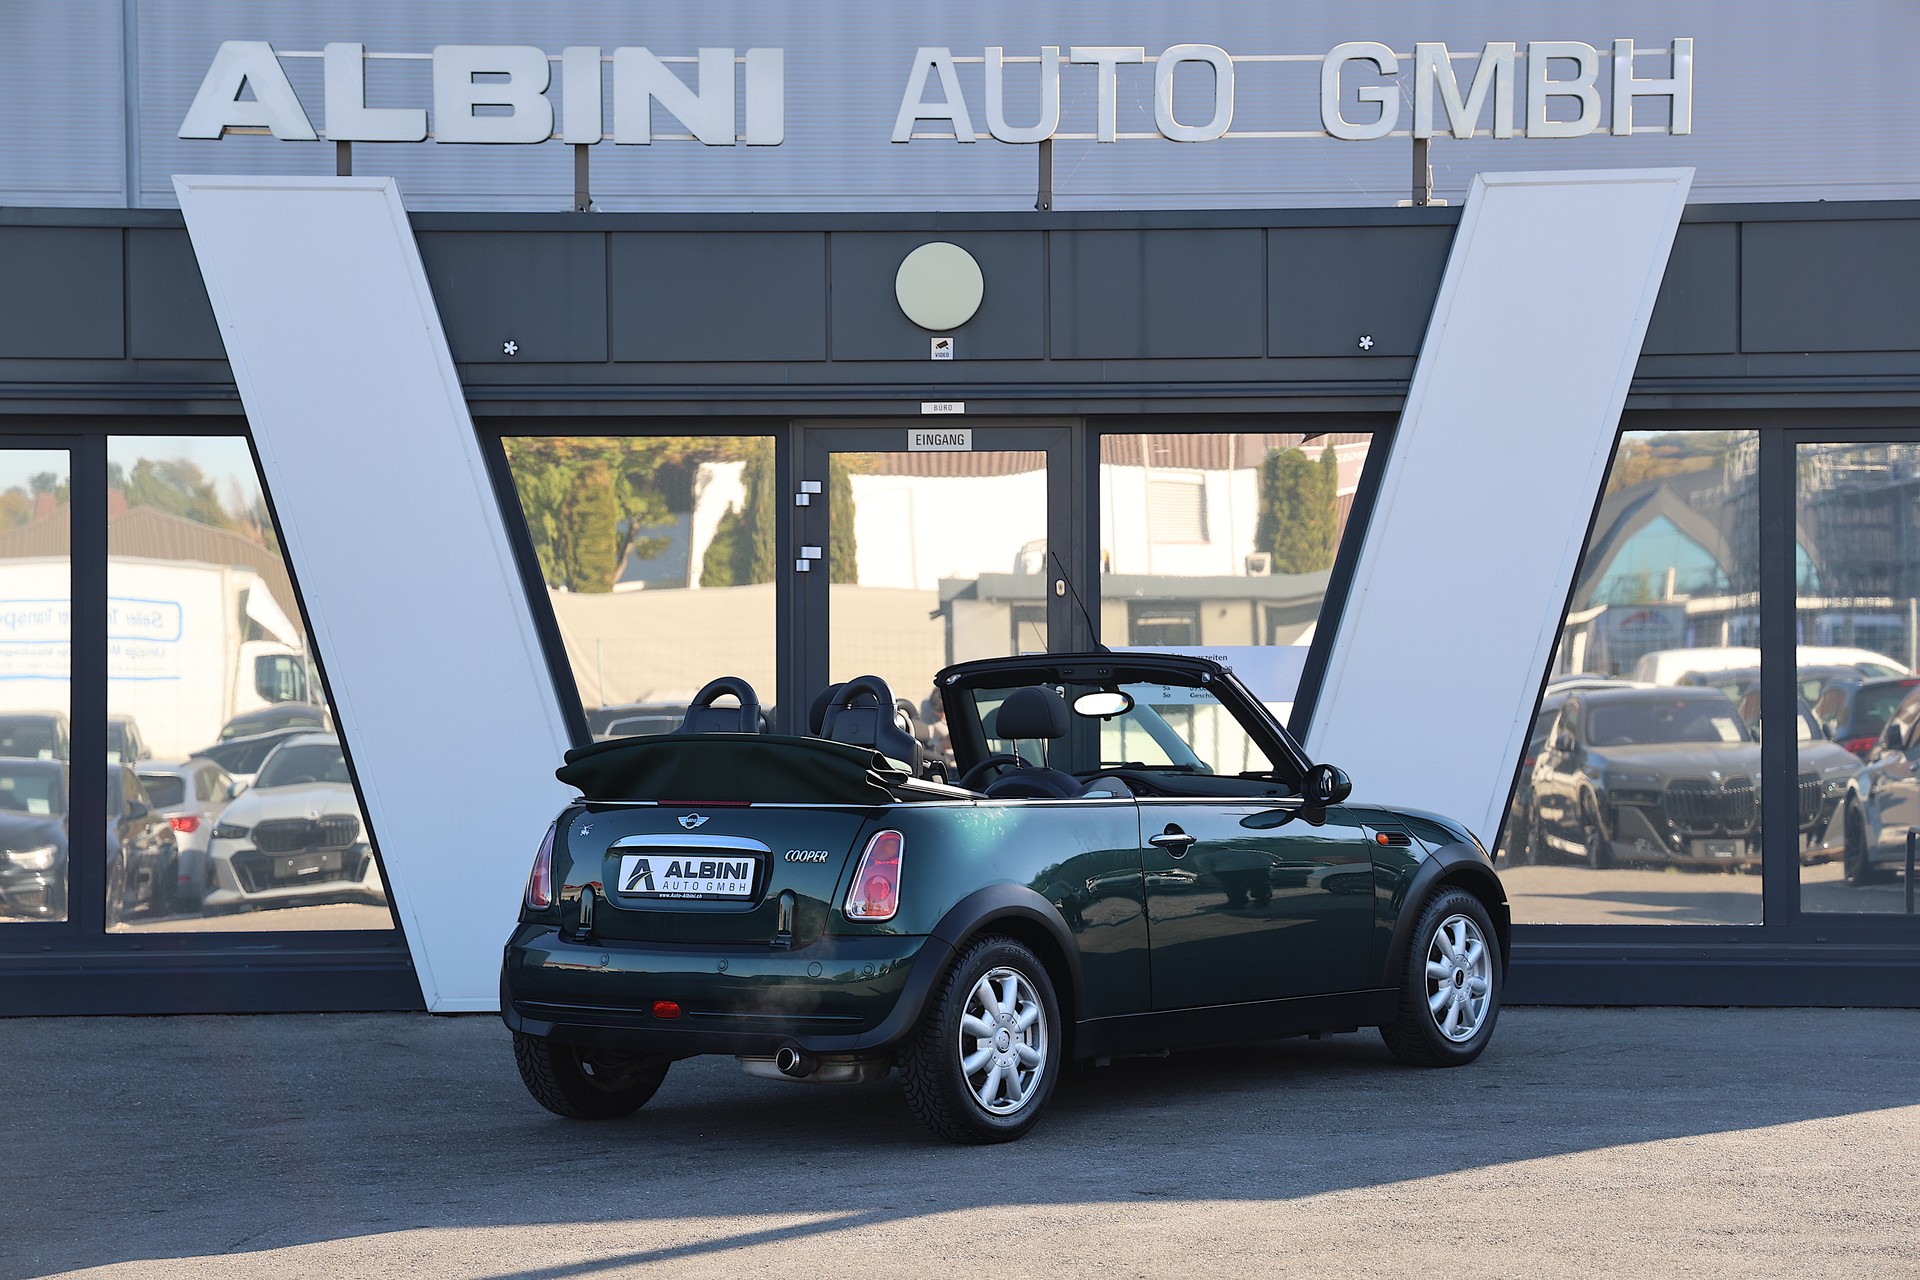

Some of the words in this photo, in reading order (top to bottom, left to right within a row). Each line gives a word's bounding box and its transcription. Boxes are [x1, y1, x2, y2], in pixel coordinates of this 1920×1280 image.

[178, 40, 785, 147] ALBINI
[891, 43, 1235, 144] AUTO
[1319, 37, 1694, 140] GMBH
[915, 434, 965, 446] EINGANG
[784, 849, 829, 863] COOPER
[664, 860, 749, 880] ALBINI
[662, 881, 700, 891] AUTO
[705, 881, 747, 892] GMBH
